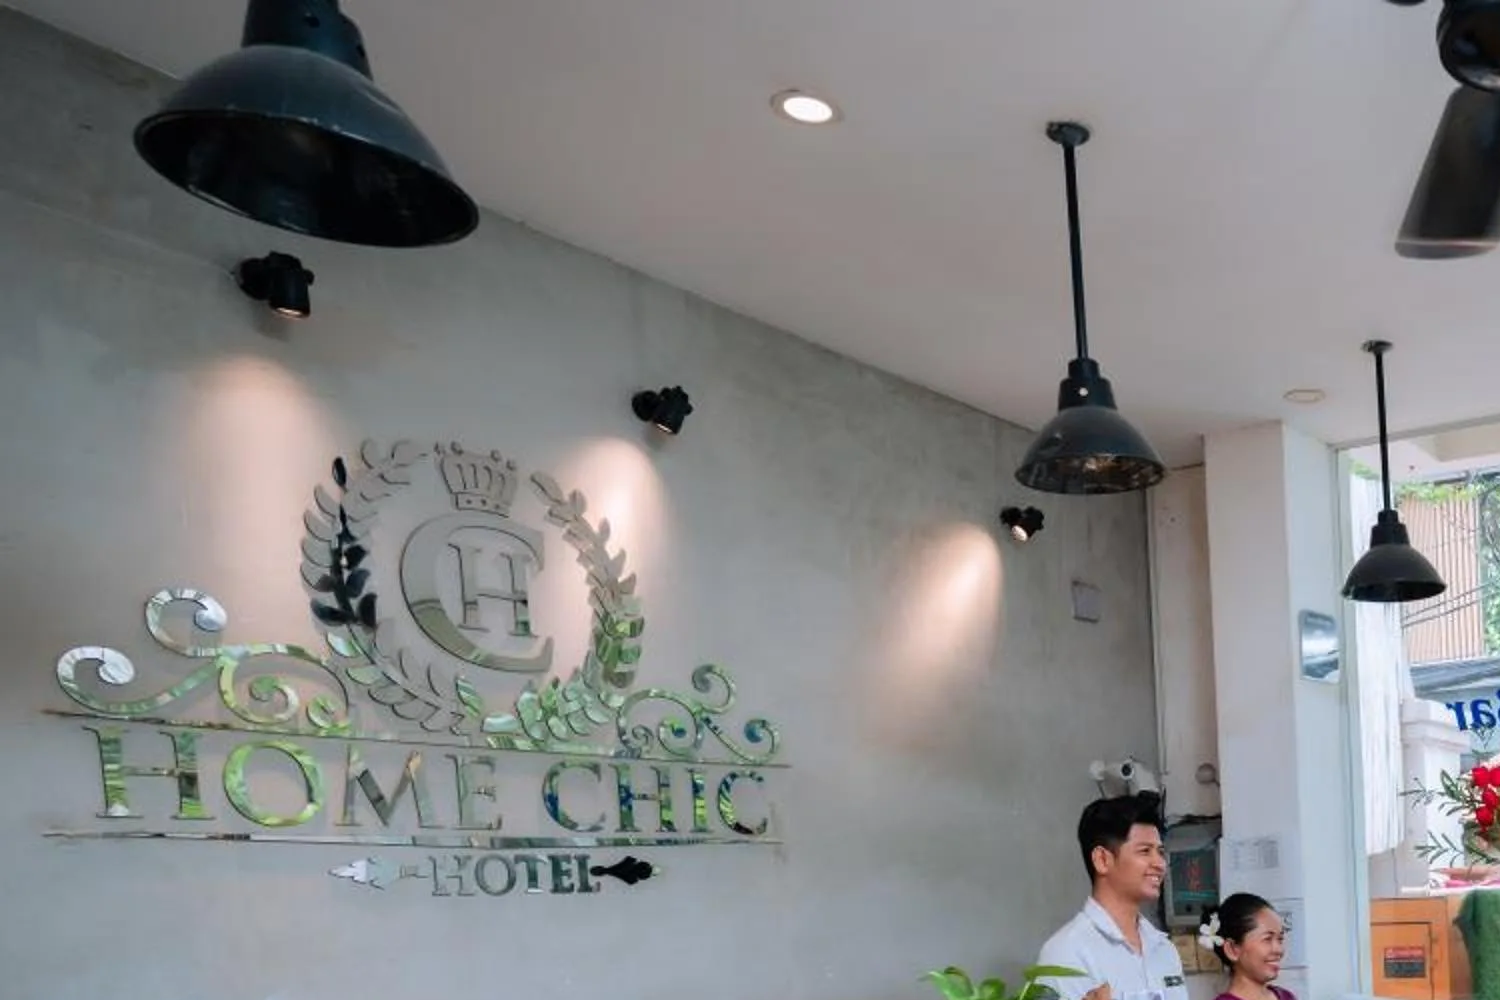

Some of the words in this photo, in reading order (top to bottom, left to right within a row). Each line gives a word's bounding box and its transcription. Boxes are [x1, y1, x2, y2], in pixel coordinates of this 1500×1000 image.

[82, 724, 504, 831] HOME
[541, 762, 772, 836] CHIC
[430, 852, 602, 898] HOTEL
